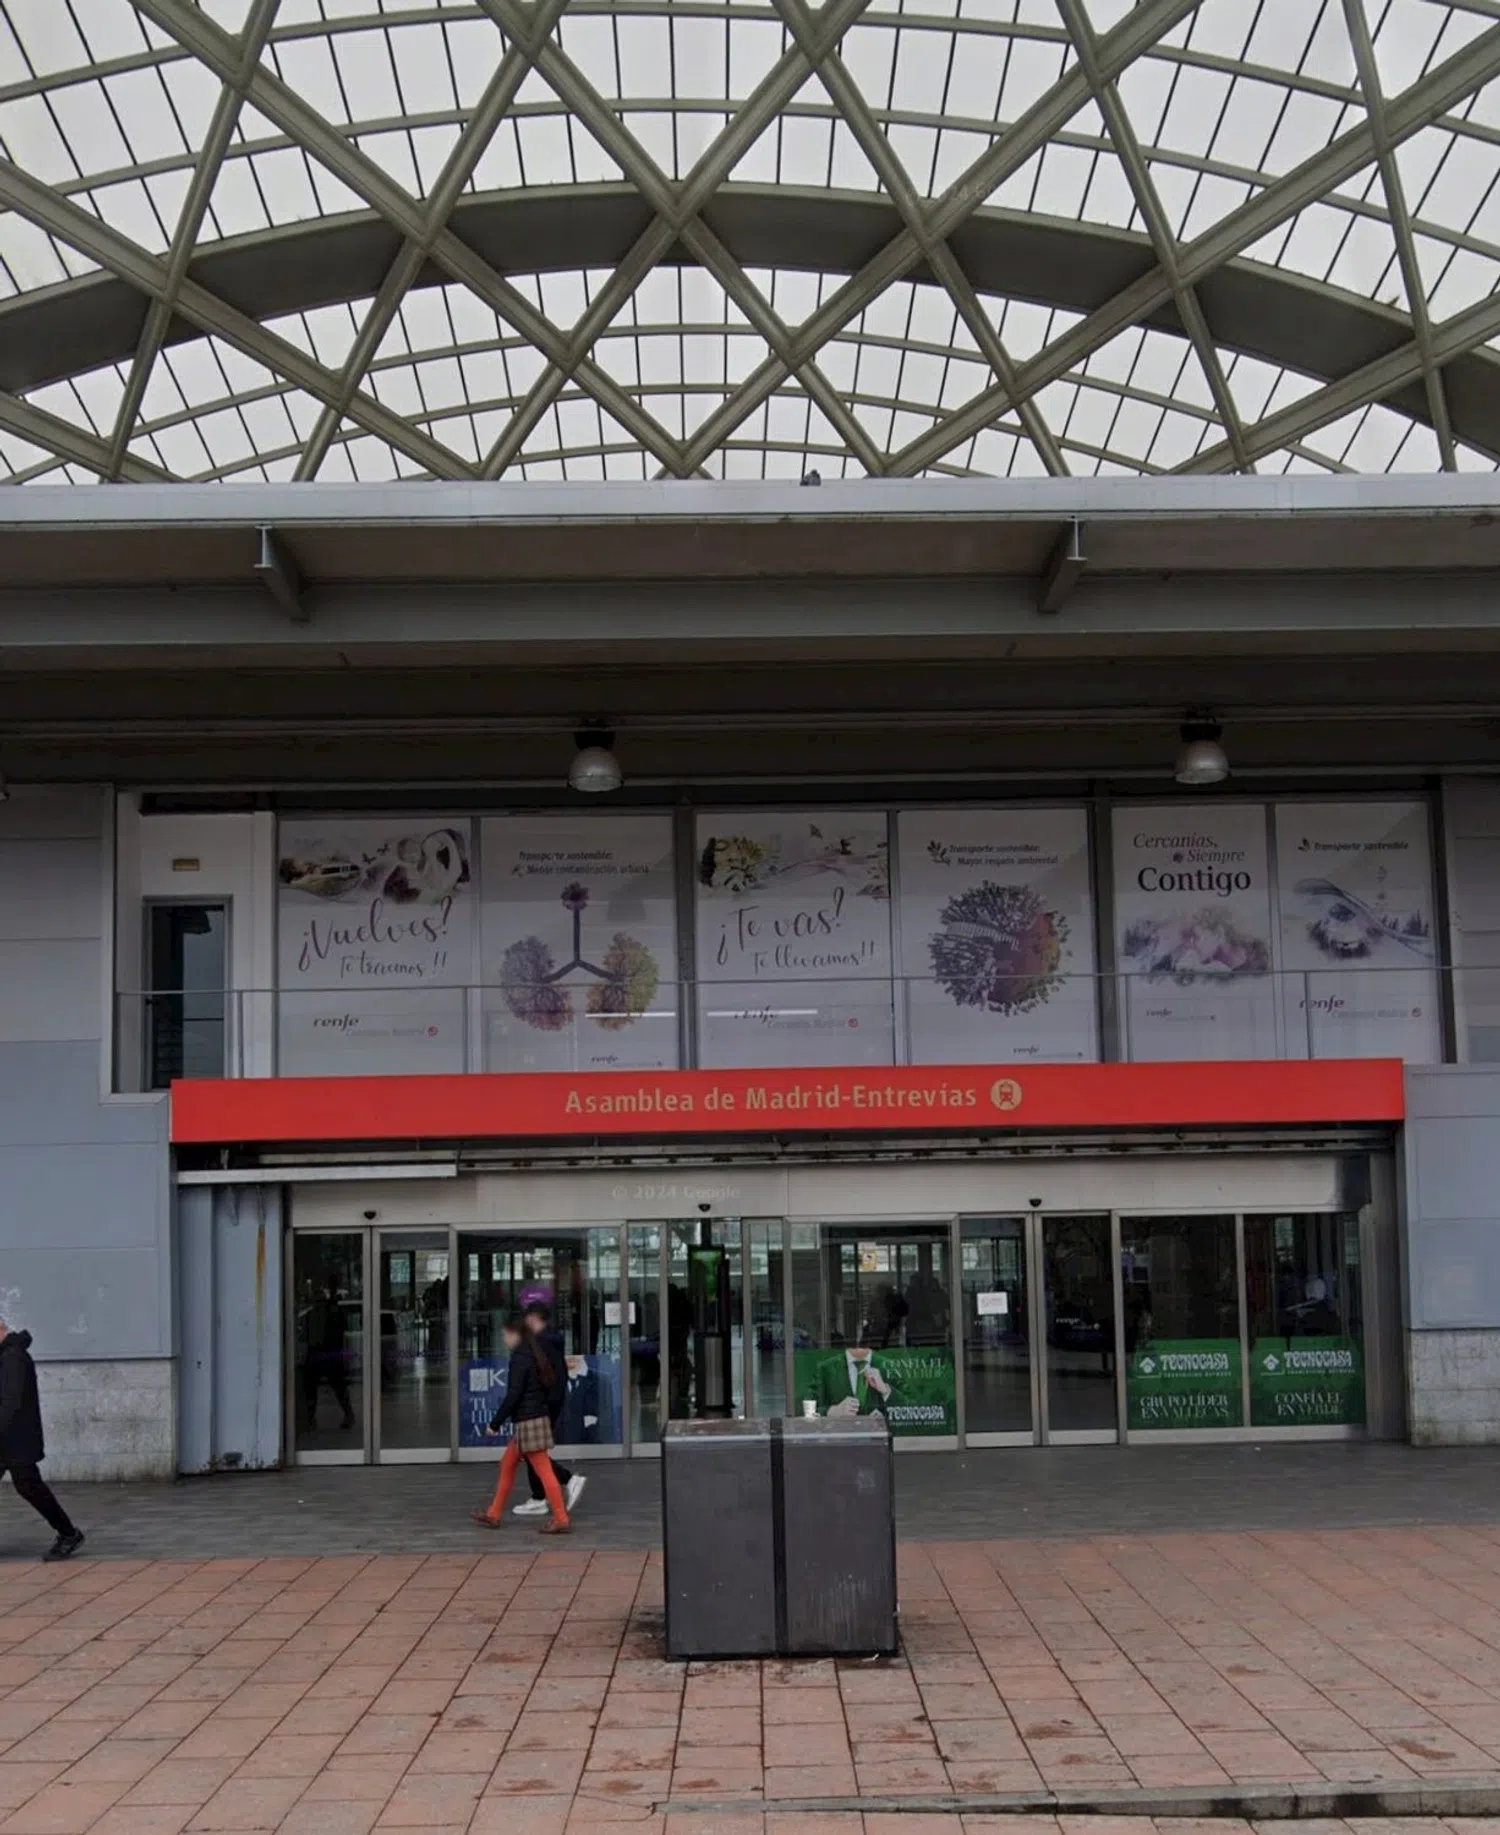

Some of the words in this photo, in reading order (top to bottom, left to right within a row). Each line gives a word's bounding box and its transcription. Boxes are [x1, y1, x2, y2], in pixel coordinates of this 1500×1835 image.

[1187, 850, 1245, 864] Siempre
[1137, 865, 1251, 897] Contigo
[774, 886, 845, 937] vas?
[313, 1013, 360, 1032] renfe
[564, 1088, 694, 1113] Asamblea
[704, 1087, 735, 1111] de
[745, 1083, 977, 1110] Madrid-Entrevías
[1160, 1353, 1229, 1371] TECNOCASA
[1284, 1351, 1352, 1368] TECNOCASA
[1140, 1395, 1187, 1408] GRUPO
[886, 1405, 945, 1421] TECNOCASA
[1141, 1407, 1159, 1419] EN
[1161, 1406, 1229, 1418] VALLECAS
